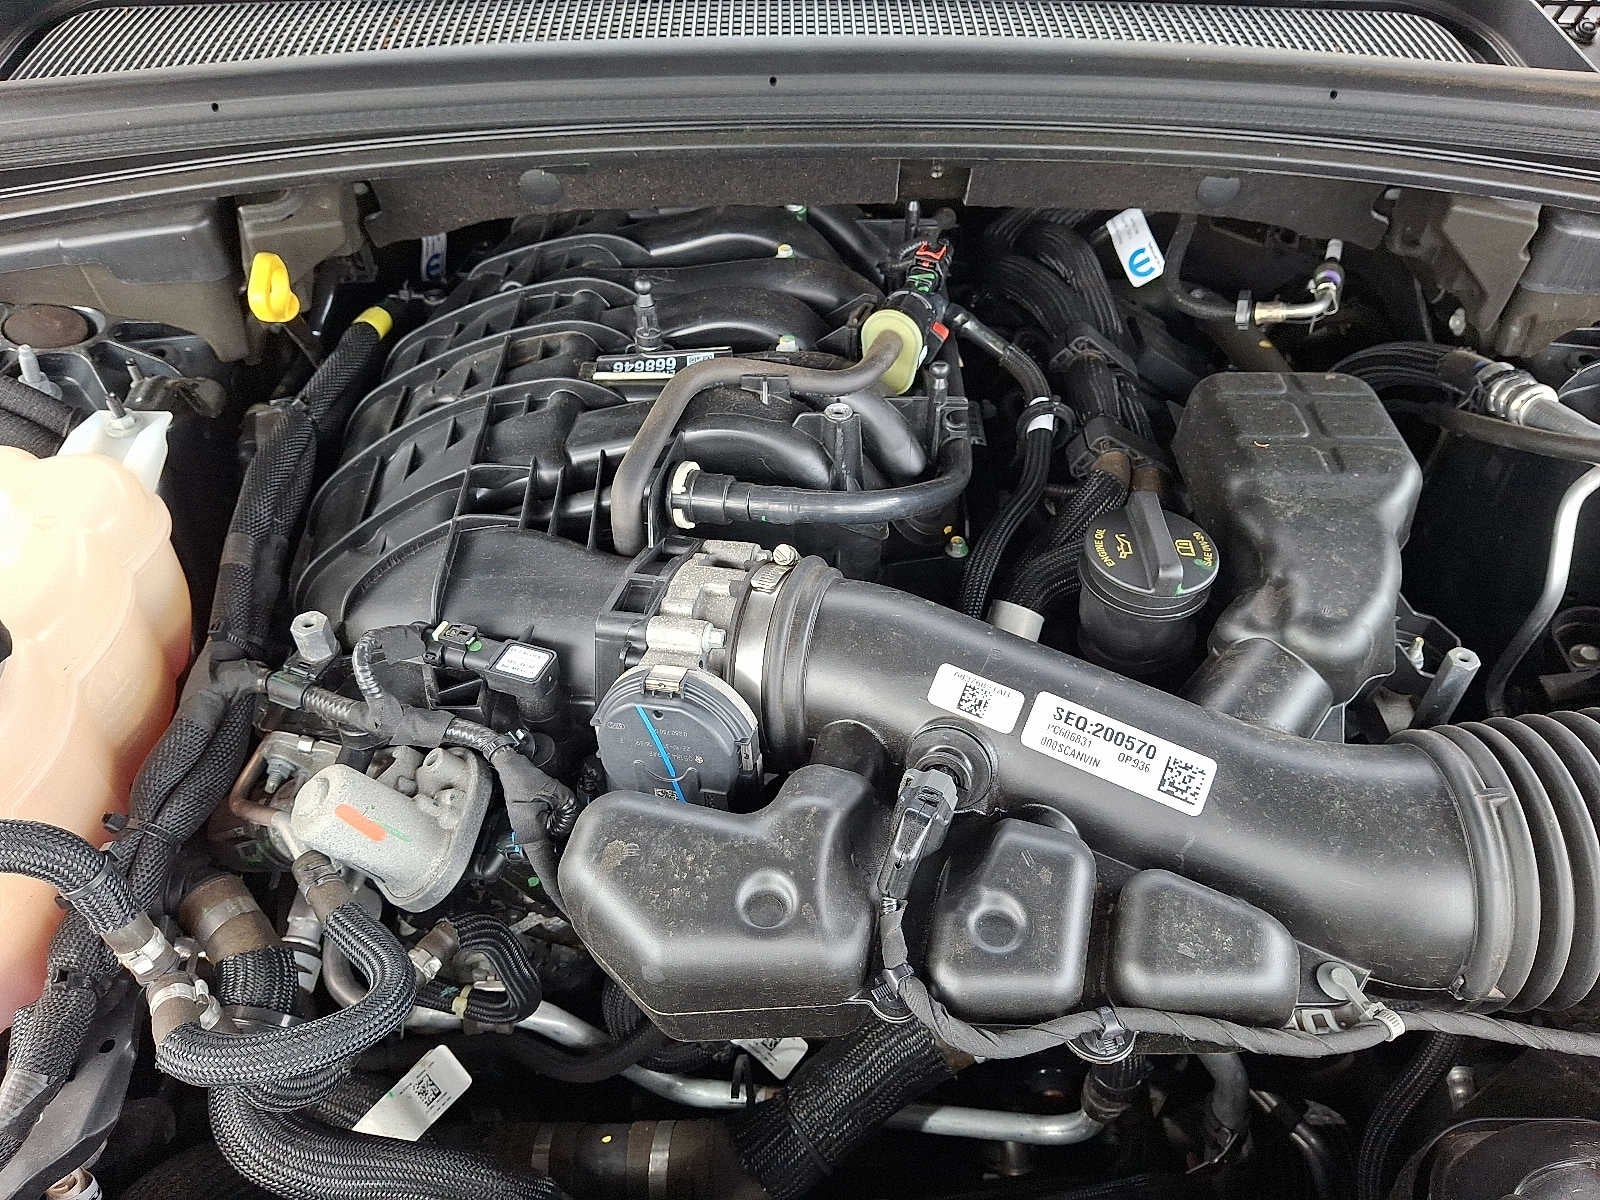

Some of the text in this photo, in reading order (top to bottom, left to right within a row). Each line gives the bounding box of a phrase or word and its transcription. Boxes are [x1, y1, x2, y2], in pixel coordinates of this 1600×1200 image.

[613, 357, 677, 373] 668646
[1094, 528, 1116, 568] ENGINE OIL
[1053, 706, 1157, 760] SEQ:200570
